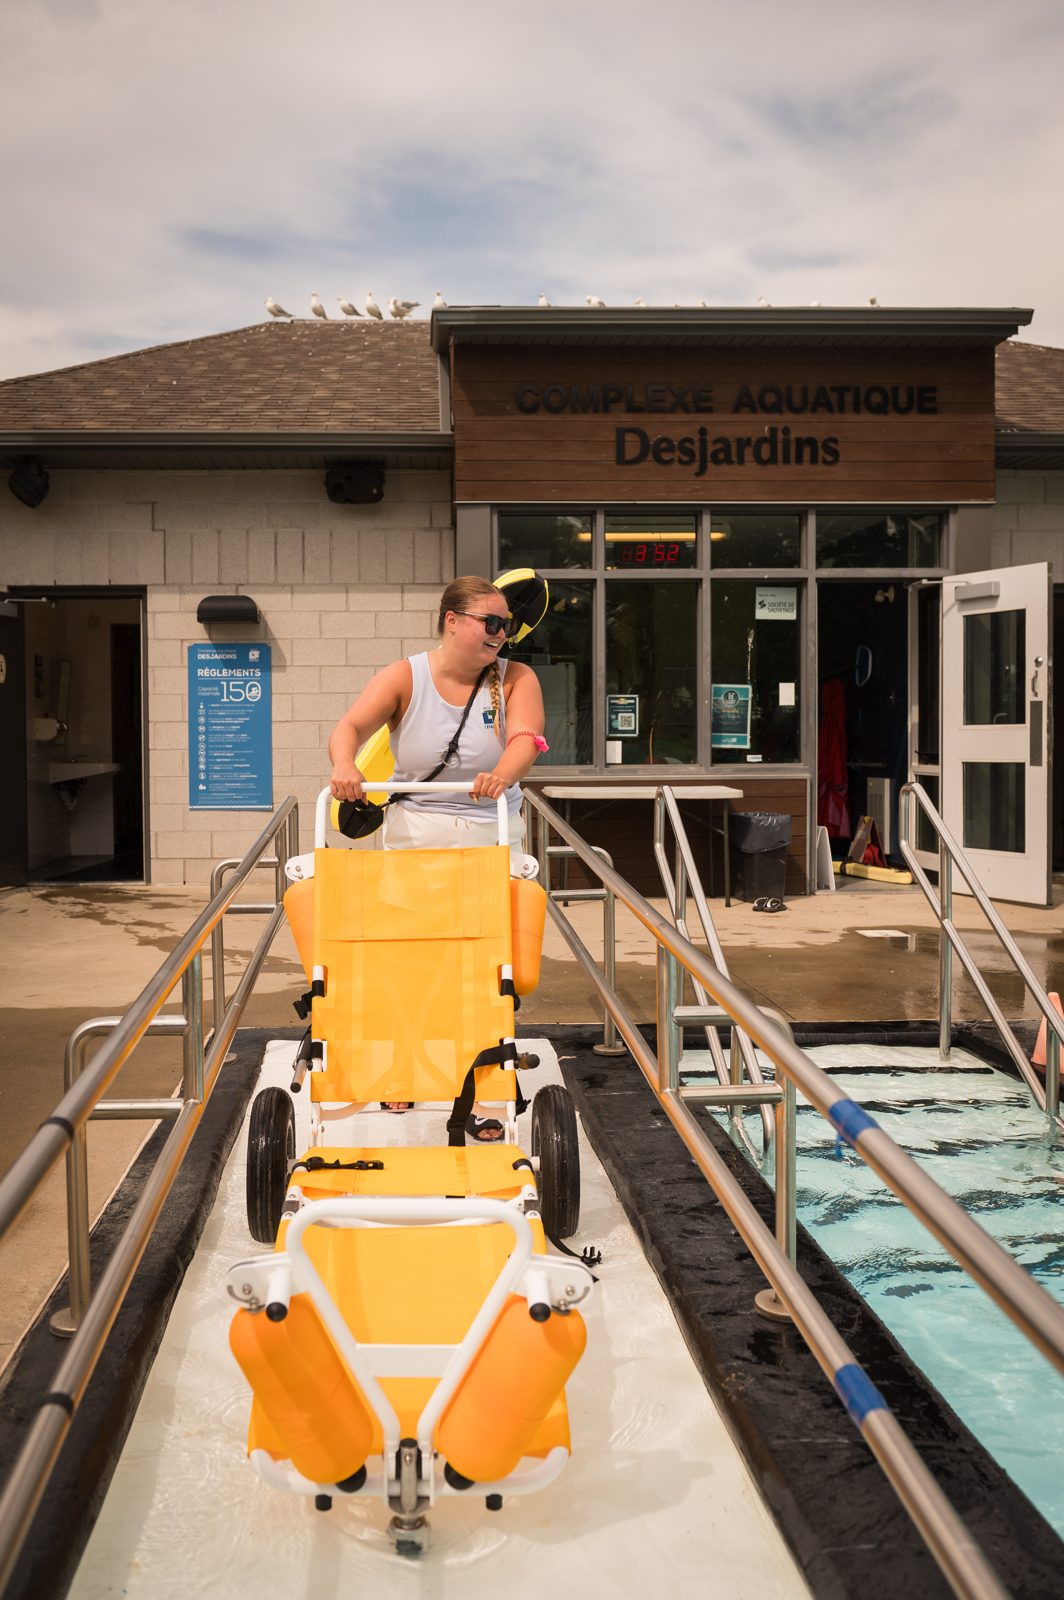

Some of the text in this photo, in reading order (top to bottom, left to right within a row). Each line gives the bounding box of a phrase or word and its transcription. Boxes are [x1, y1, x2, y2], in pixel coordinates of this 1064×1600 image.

[514, 384, 938, 415] COMPLEXE AQUATIQUE
[615, 426, 840, 477] Desjardins
[220, 681, 262, 702] 150
